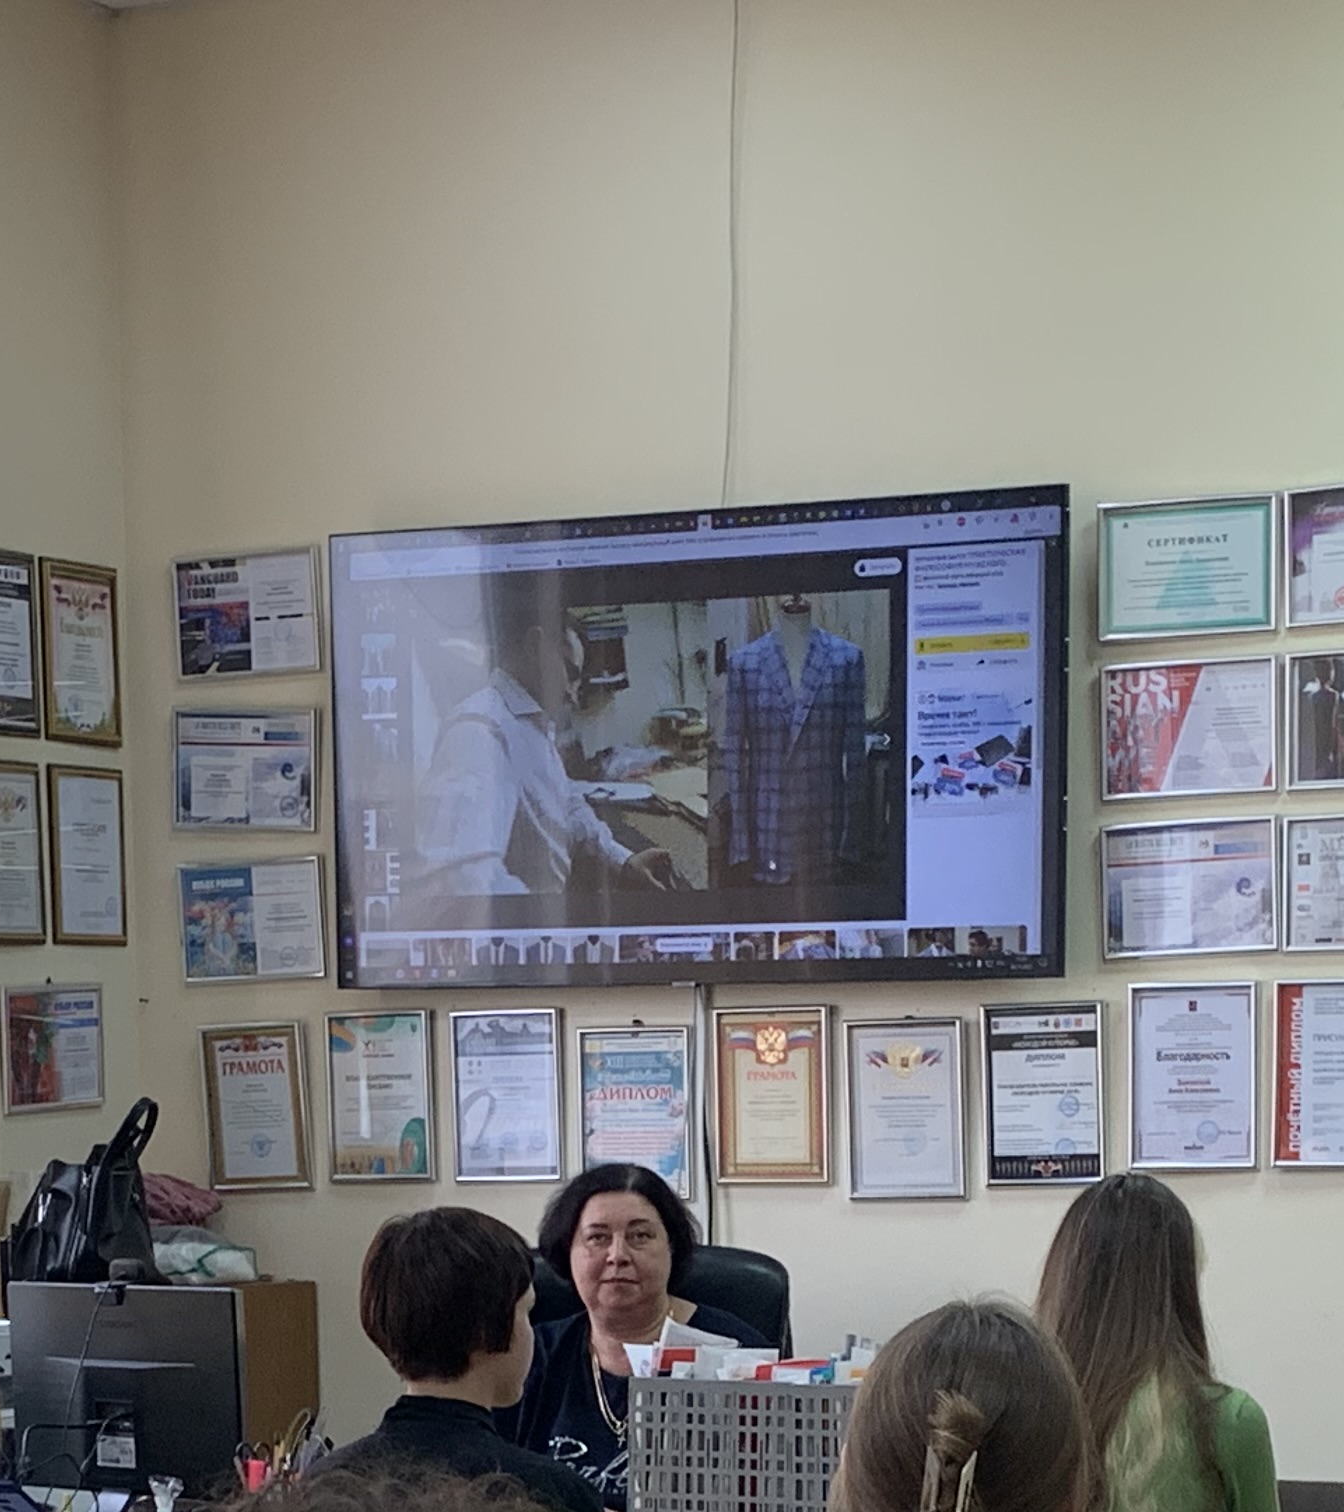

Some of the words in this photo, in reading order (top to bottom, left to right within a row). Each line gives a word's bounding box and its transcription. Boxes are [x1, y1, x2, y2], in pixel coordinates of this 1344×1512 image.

[1147, 533, 1228, 548] СЕРТИФИКАТ
[1107, 668, 1168, 695] RUS
[1107, 690, 1181, 718] SIAN
[1290, 998, 1304, 1064] ДИПЛОМ
[1156, 1050, 1231, 1062] Благодарность
[222, 1059, 285, 1076] ГРАМОТА
[747, 1071, 797, 1081] ГРАМОТА
[592, 1086, 673, 1101] ДИПЛОМ
[1287, 1067, 1302, 1152] ПОЧЁТНЫЙ
